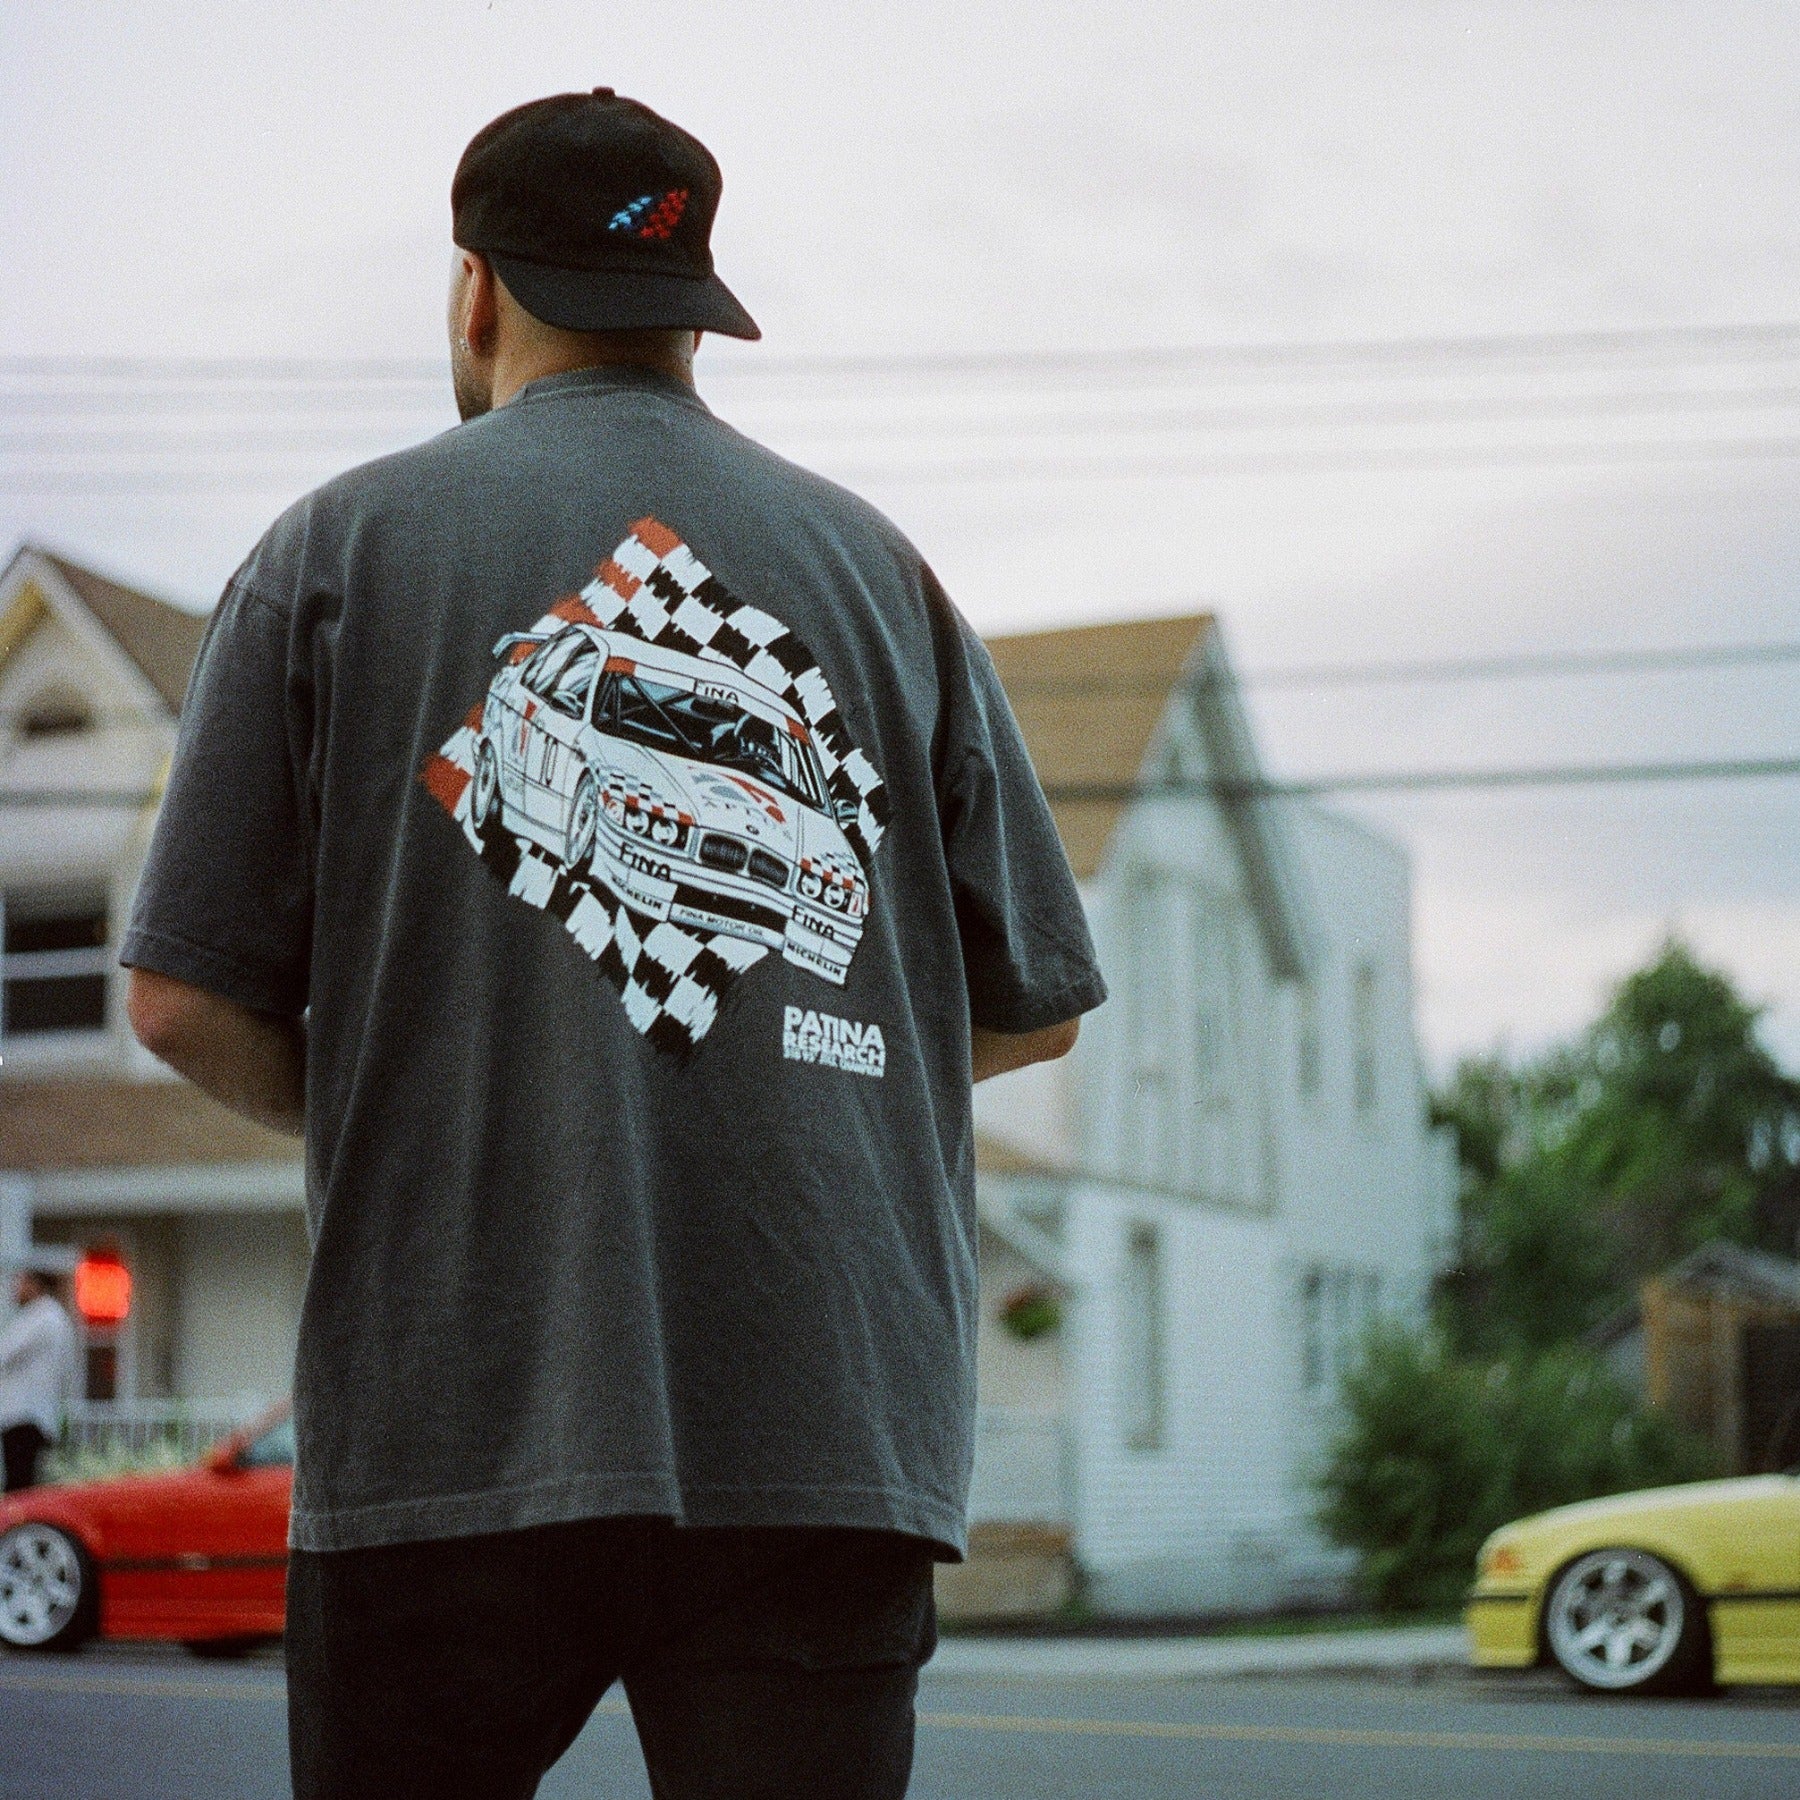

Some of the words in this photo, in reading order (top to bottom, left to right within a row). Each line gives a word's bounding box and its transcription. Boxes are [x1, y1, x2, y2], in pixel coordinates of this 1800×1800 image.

[619, 841, 670, 881] FINA
[793, 904, 834, 940] FINA
[786, 942, 841, 975] MICHELIN
[783, 1005, 885, 1049] PATINA
[783, 1031, 886, 1066] RESEARCH
